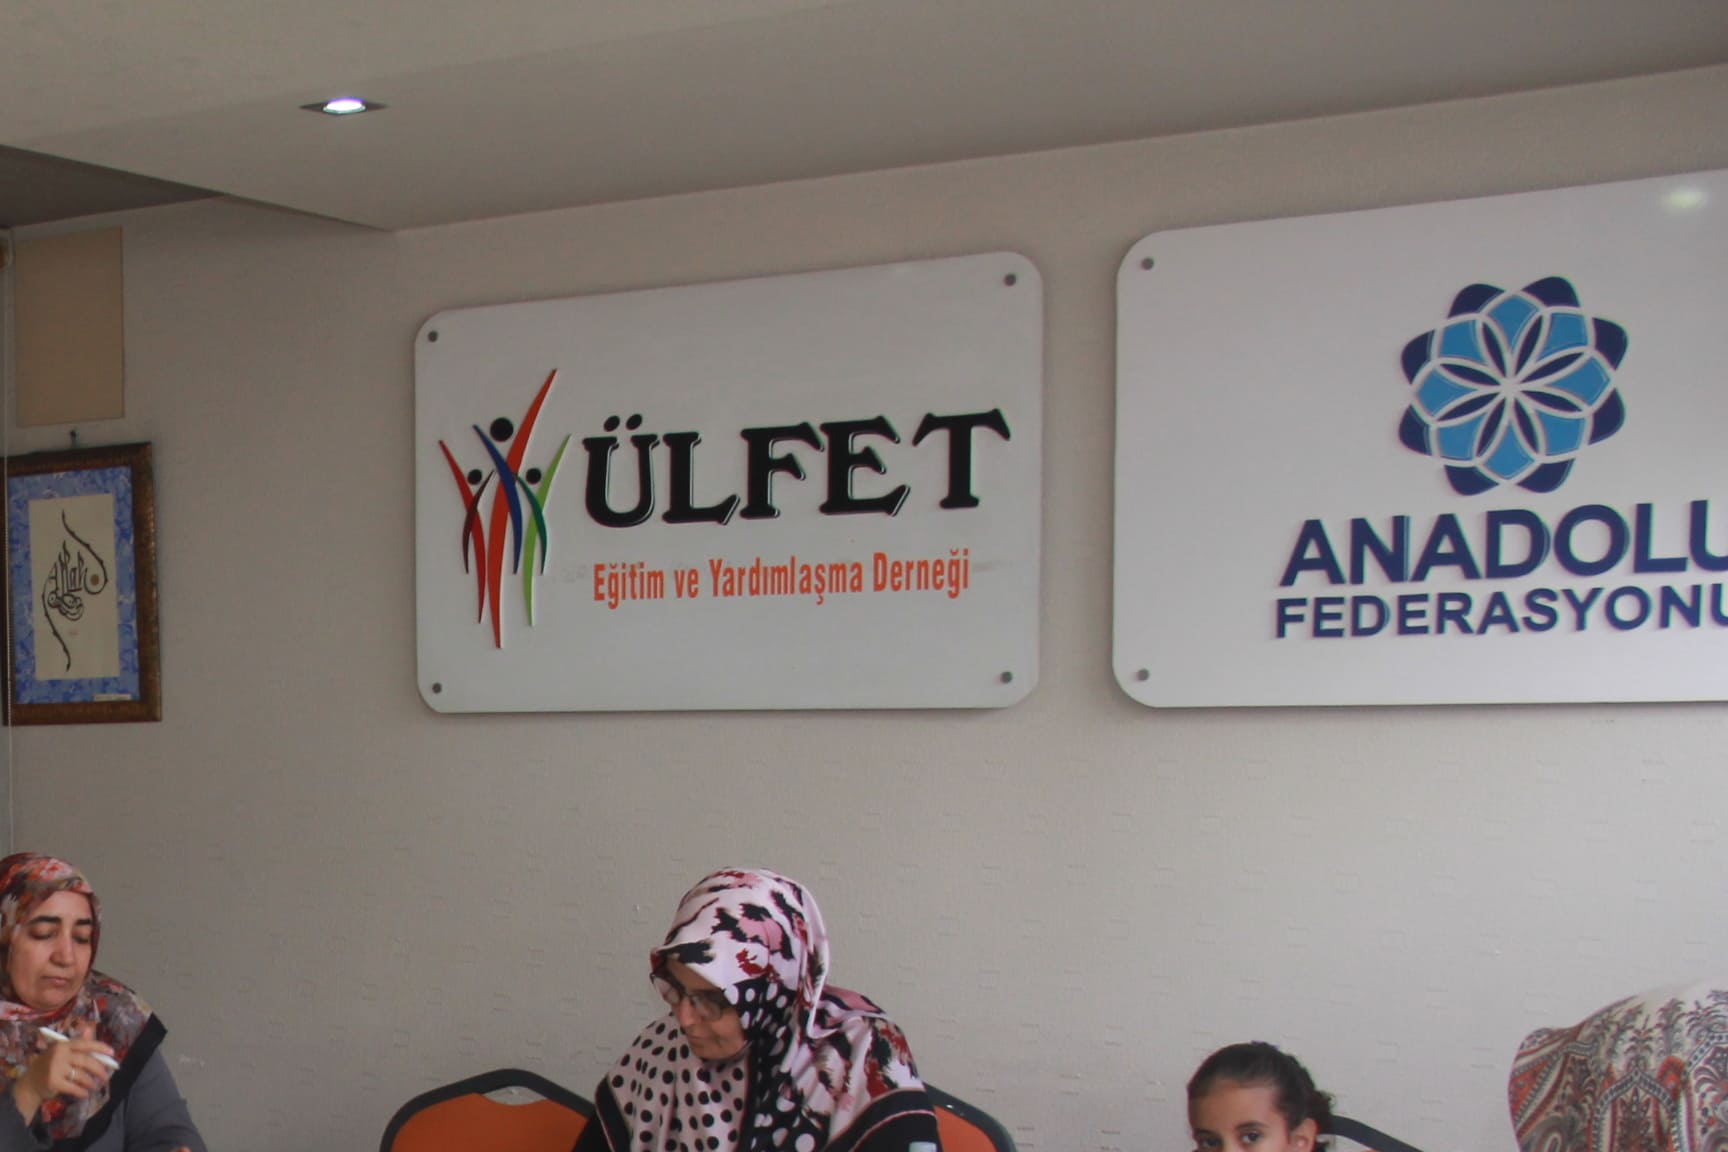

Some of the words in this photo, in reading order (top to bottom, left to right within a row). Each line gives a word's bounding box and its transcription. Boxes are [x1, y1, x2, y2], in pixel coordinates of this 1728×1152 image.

[582, 408, 1011, 528] ÜLFET
[592, 561, 665, 609] Eğitim
[674, 569, 700, 598] ve
[708, 554, 863, 605] Yardımlaşma
[873, 548, 971, 599] Derneği
[1278, 500, 1728, 587] ANADOLU
